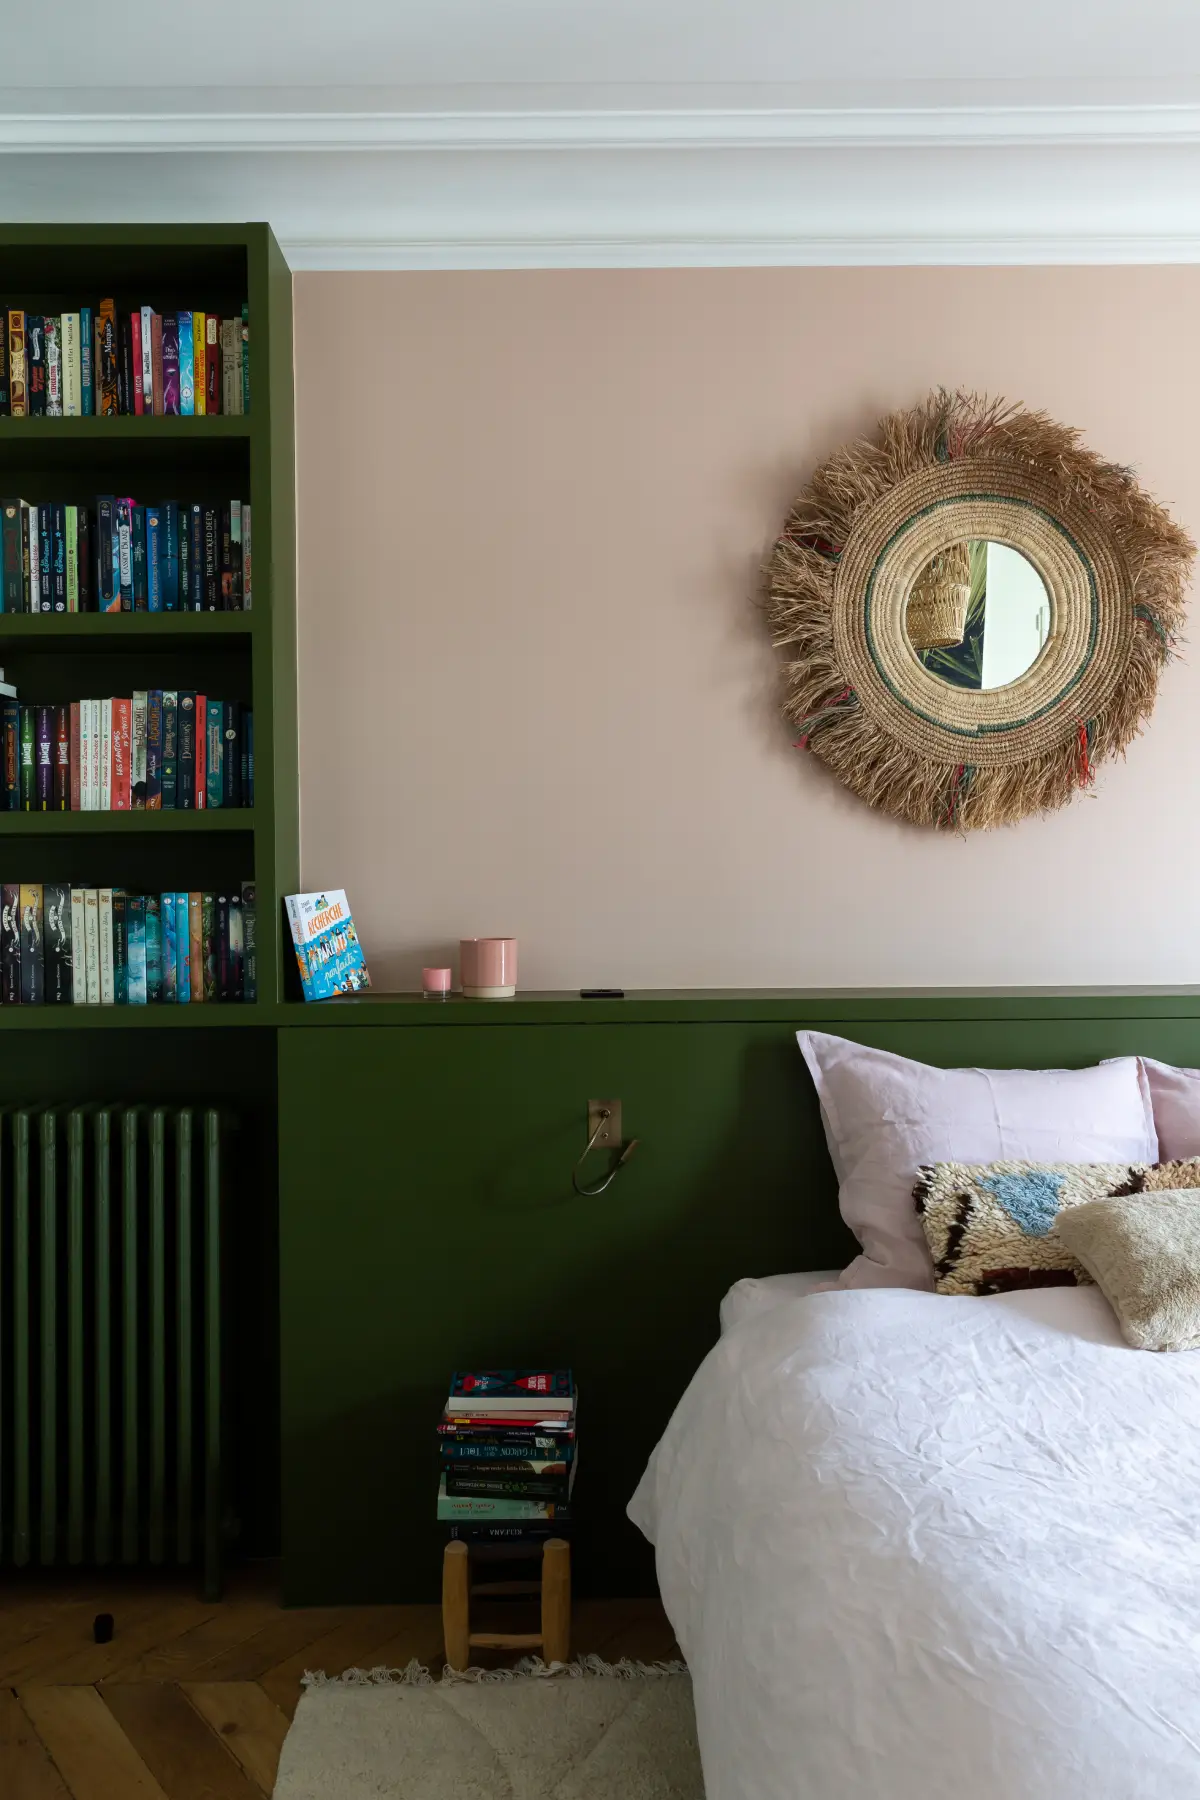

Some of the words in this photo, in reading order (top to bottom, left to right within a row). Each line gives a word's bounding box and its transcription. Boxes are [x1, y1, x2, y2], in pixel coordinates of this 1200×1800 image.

[81, 347, 90, 387] QUINTLAND
[204, 511, 212, 531] DEEP
[119, 527, 127, 550] BLAKE
[204, 533, 212, 562] WICKED
[120, 552, 128, 575] CASSIDY
[132, 707, 144, 747] L'ACADÉMIE
[21, 742, 32, 766] MANOIR
[39, 742, 50, 765] MANOIR
[58, 742, 68, 765] MANOIR
[115, 763, 123, 775] LES
[307, 902, 344, 936] RECHERCHE
[318, 933, 348, 963] PARENTS
[324, 952, 356, 988] parfaits
[459, 1447, 480, 1456] TOUT
